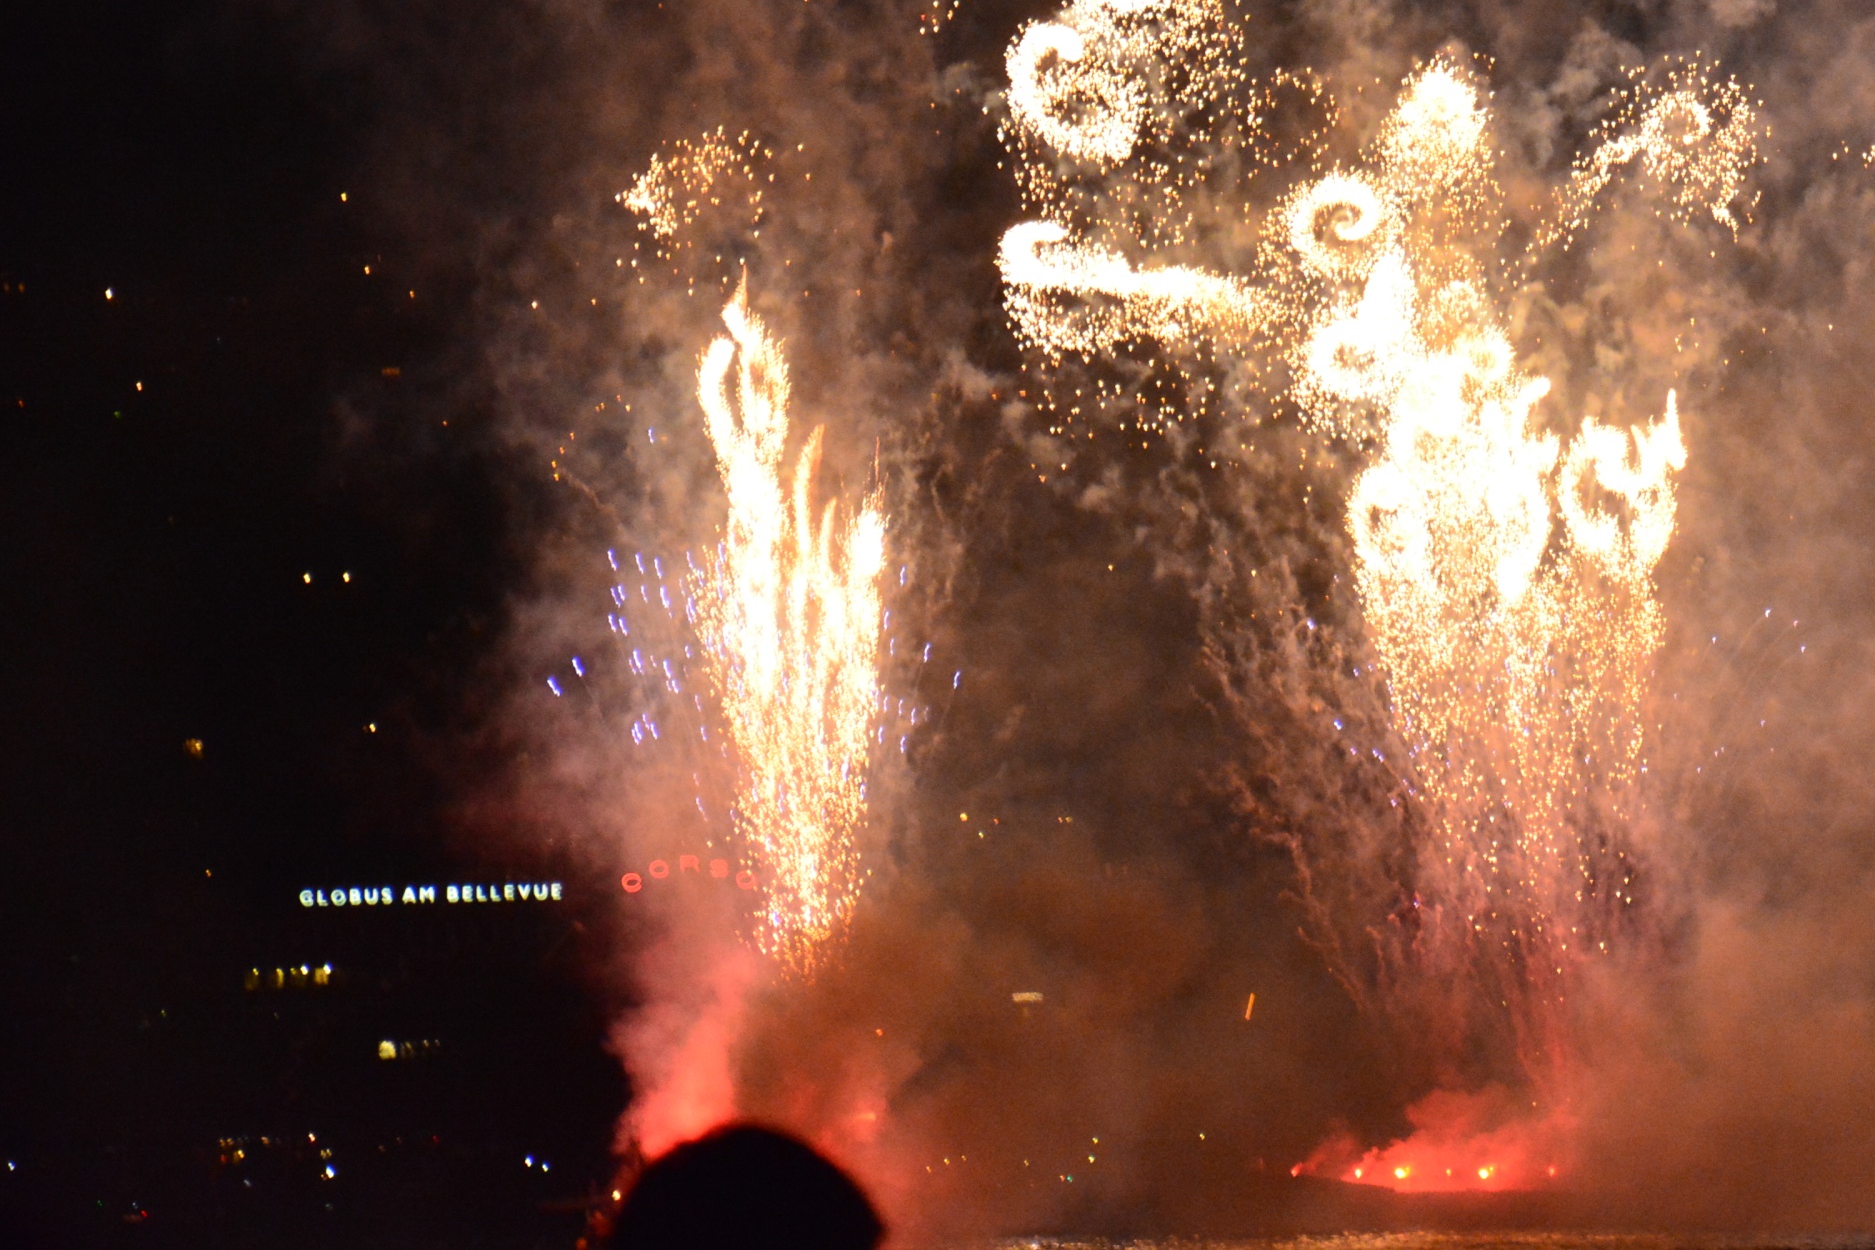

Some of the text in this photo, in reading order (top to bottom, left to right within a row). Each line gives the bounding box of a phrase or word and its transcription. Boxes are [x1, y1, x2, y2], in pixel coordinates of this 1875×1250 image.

[621, 854, 758, 893] CORSO
[299, 882, 563, 907] GLOBUS AM BELLEVUE
